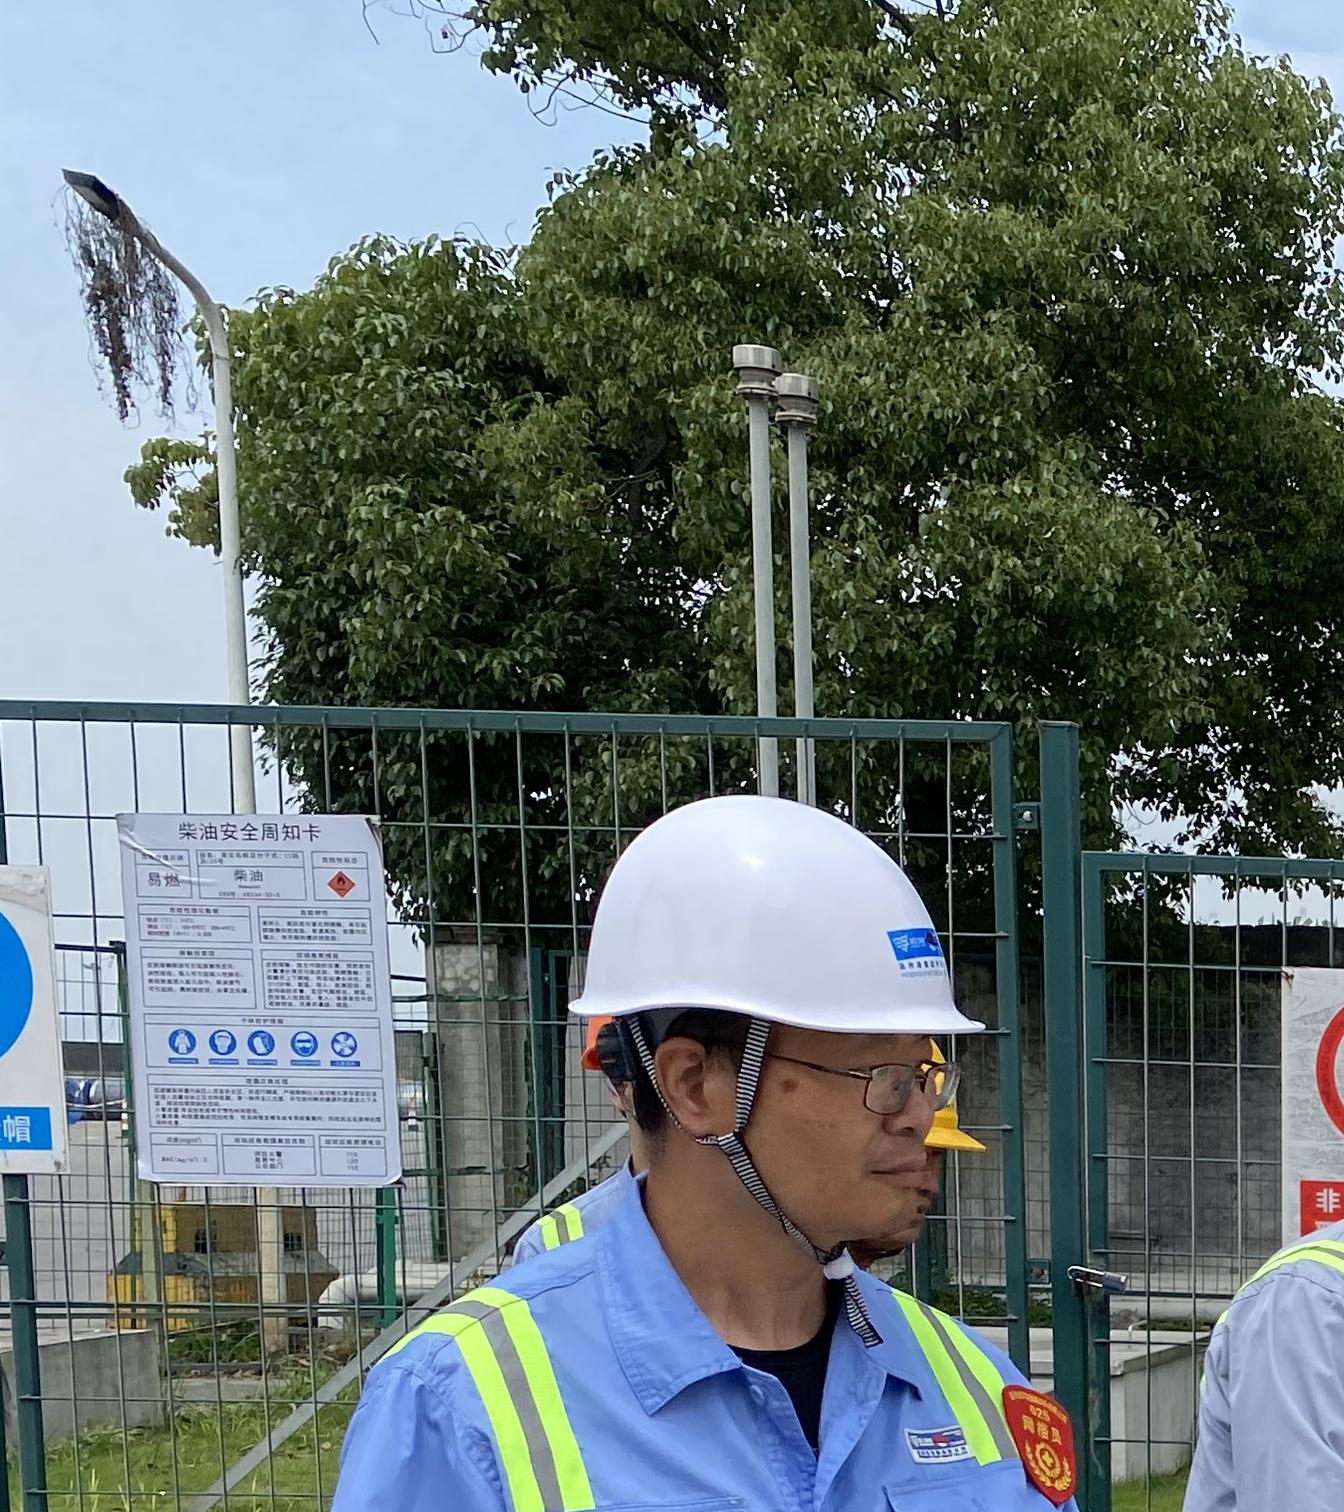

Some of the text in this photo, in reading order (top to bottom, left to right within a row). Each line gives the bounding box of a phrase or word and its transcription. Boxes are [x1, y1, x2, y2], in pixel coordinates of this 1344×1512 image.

[178, 821, 322, 843] 柴油安全周知卡
[147, 871, 182, 889] 易燃
[233, 869, 264, 883] 柴油
[0, 1114, 31, 1144] 帽
